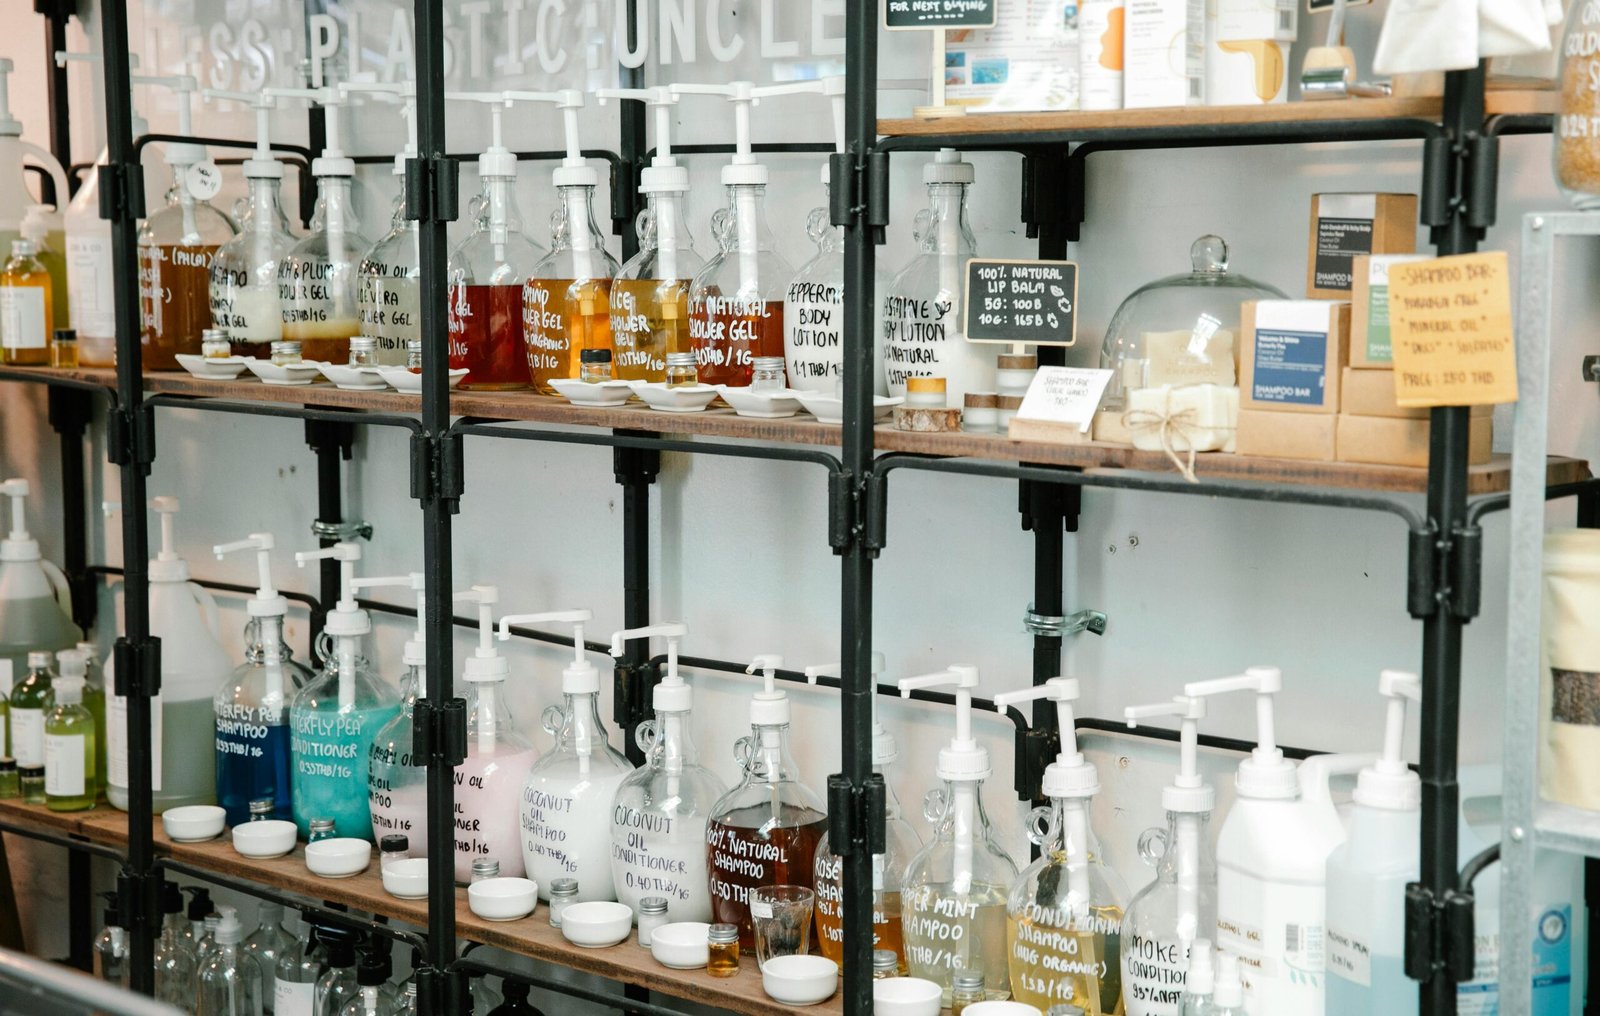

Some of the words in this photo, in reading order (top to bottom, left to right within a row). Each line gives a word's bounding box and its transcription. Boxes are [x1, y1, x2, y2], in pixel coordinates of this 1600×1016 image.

[890, 2, 909, 12] FOR
[912, 1, 940, 12] NEXT
[944, 0, 988, 11] BUYING
[302, 261, 334, 281] PLUM
[978, 265, 1007, 280] 100%
[1012, 266, 1063, 280] NATURAL
[1316, 272, 1346, 282] SHAMPOO
[310, 284, 330, 301] GEL
[987, 281, 1007, 293] LIP
[1011, 280, 1045, 294] BALM
[706, 296, 771, 318] NATURAL
[984, 297, 1007, 310] 5G:
[231, 315, 249, 328] GEL
[392, 310, 413, 327] GEL
[541, 311, 563, 331] GEL
[799, 308, 831, 326] BODY
[978, 313, 1008, 325] 10G:
[1460, 319, 1479, 332] OIL
[615, 332, 633, 346] GEL
[729, 319, 758, 341] GEL
[793, 326, 839, 347] LOTION
[900, 320, 945, 343] LOTION
[891, 345, 940, 364] NATURAL
[1255, 384, 1294, 396] SHAMPOO
[1295, 386, 1311, 397] BAR
[216, 718, 269, 739] SHAMPOO
[336, 717, 361, 737] PEA
[401, 753, 413, 767] OI
[376, 777, 392, 792] OIL
[469, 775, 484, 789] OIL
[523, 785, 573, 813] COCONUT
[530, 808, 545, 822] OIL
[614, 804, 673, 834] COCONUT
[522, 813, 566, 842] SHAMPOO
[627, 831, 648, 852] OIL
[729, 837, 789, 863] NATURAL
[611, 841, 688, 875] CONDITIONER
[715, 850, 764, 880] SHAMPOO
[815, 856, 840, 881] ROSE
[817, 880, 843, 903] SHA
[934, 897, 980, 921] MINT
[1018, 920, 1078, 955] SHAMPOO
[1132, 934, 1178, 964] MOKE
[1013, 940, 1039, 966] (HUG
[1042, 954, 1107, 979] ORGANIC)
[1159, 990, 1182, 1005] NAT
